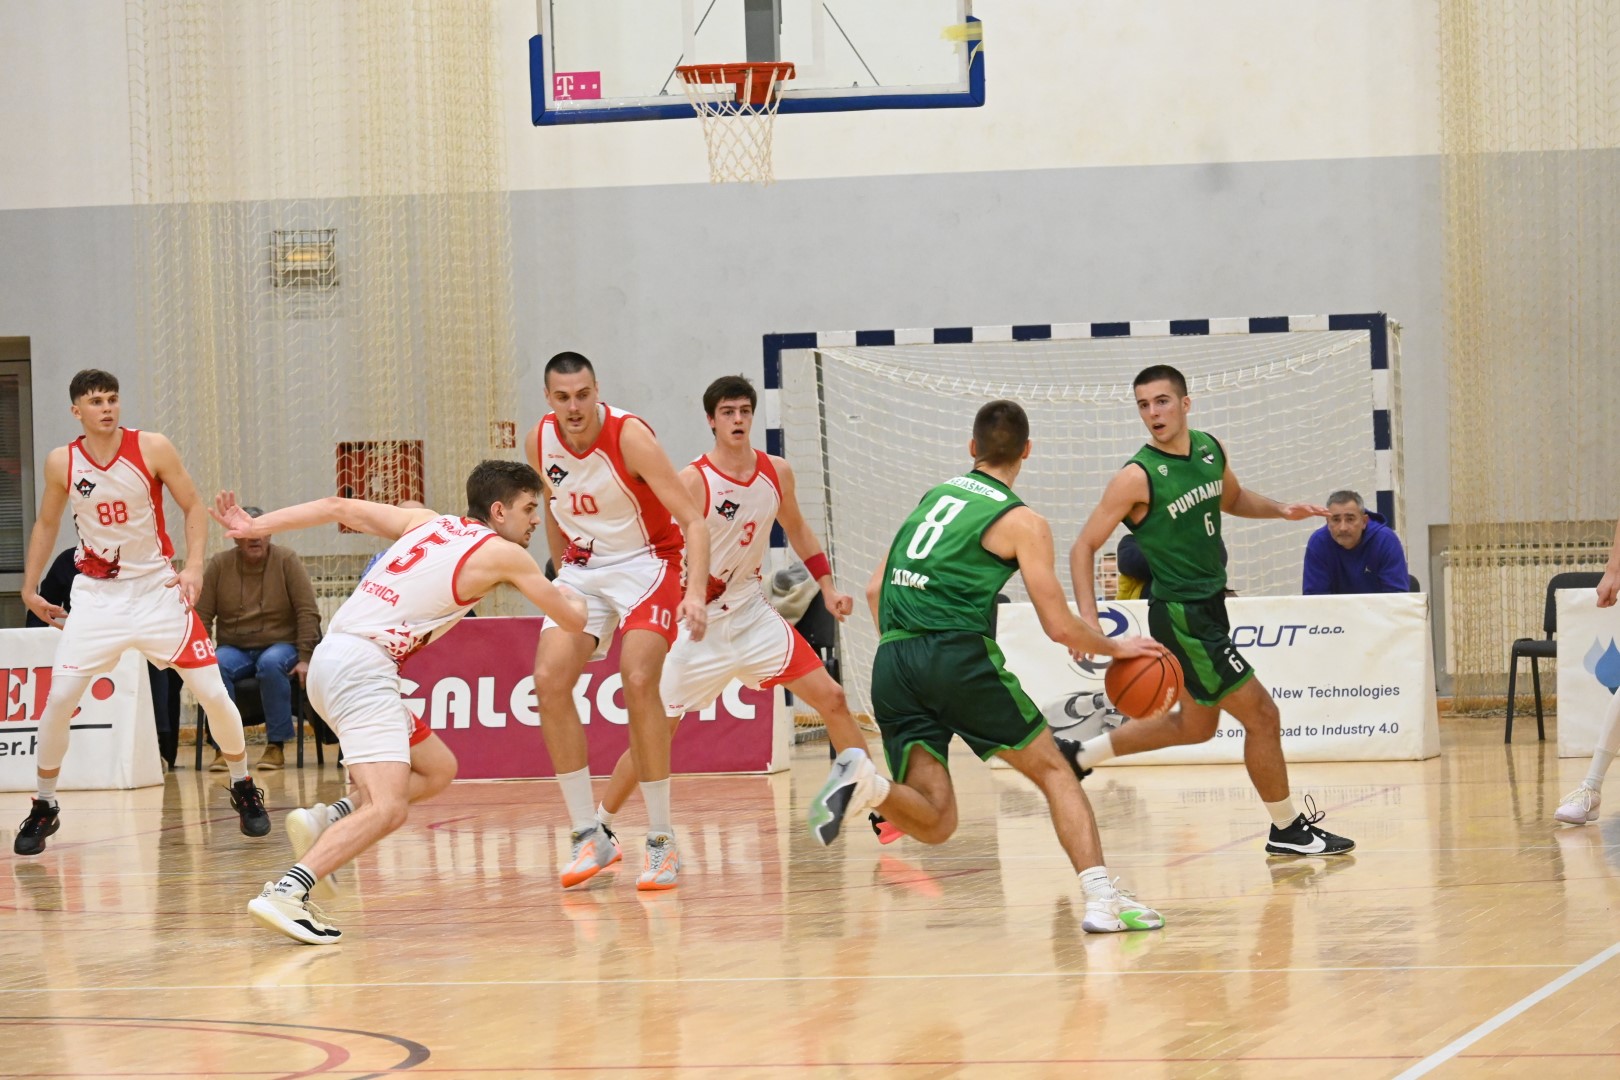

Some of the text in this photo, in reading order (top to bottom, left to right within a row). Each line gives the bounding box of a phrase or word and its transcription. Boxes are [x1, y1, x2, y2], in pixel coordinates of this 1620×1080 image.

[96, 501, 128, 526] 88
[569, 491, 599, 517] 10
[740, 521, 757, 548] 3
[906, 495, 969, 560] 8
[1203, 511, 1216, 537] 6
[386, 530, 450, 575] 5
[648, 604, 672, 630] 10
[1308, 625, 1345, 635] d.o.o.
[192, 638, 216, 660] 88
[1228, 653, 1245, 674] 6
[1272, 684, 1400, 700] New Technologies
[1227, 729, 1243, 738] on
[1305, 726, 1318, 736] to
[1322, 724, 1375, 738] Industry
[1379, 723, 1399, 734] 4.0
